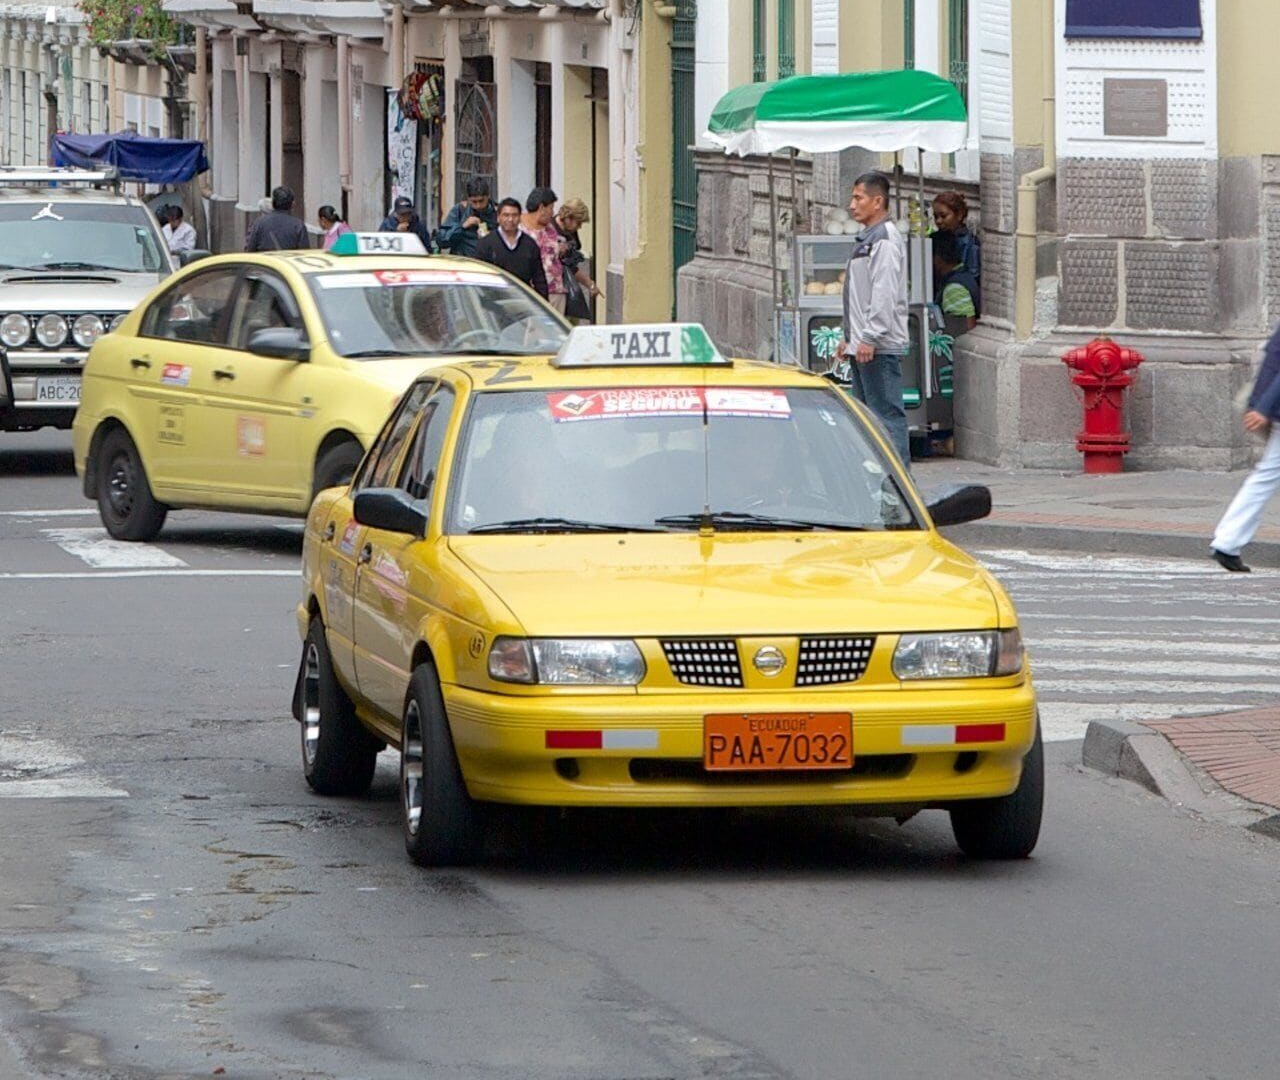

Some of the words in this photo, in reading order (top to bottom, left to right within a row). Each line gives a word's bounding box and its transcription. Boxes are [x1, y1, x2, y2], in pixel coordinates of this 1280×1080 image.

[360, 236, 403, 252] TAXI
[611, 331, 671, 359] TAXI
[600, 388, 697, 401] TRANSPORTE
[603, 397, 692, 413] SEGURO
[749, 719, 807, 732] ECUADOR
[709, 733, 848, 765] PAA-7032
